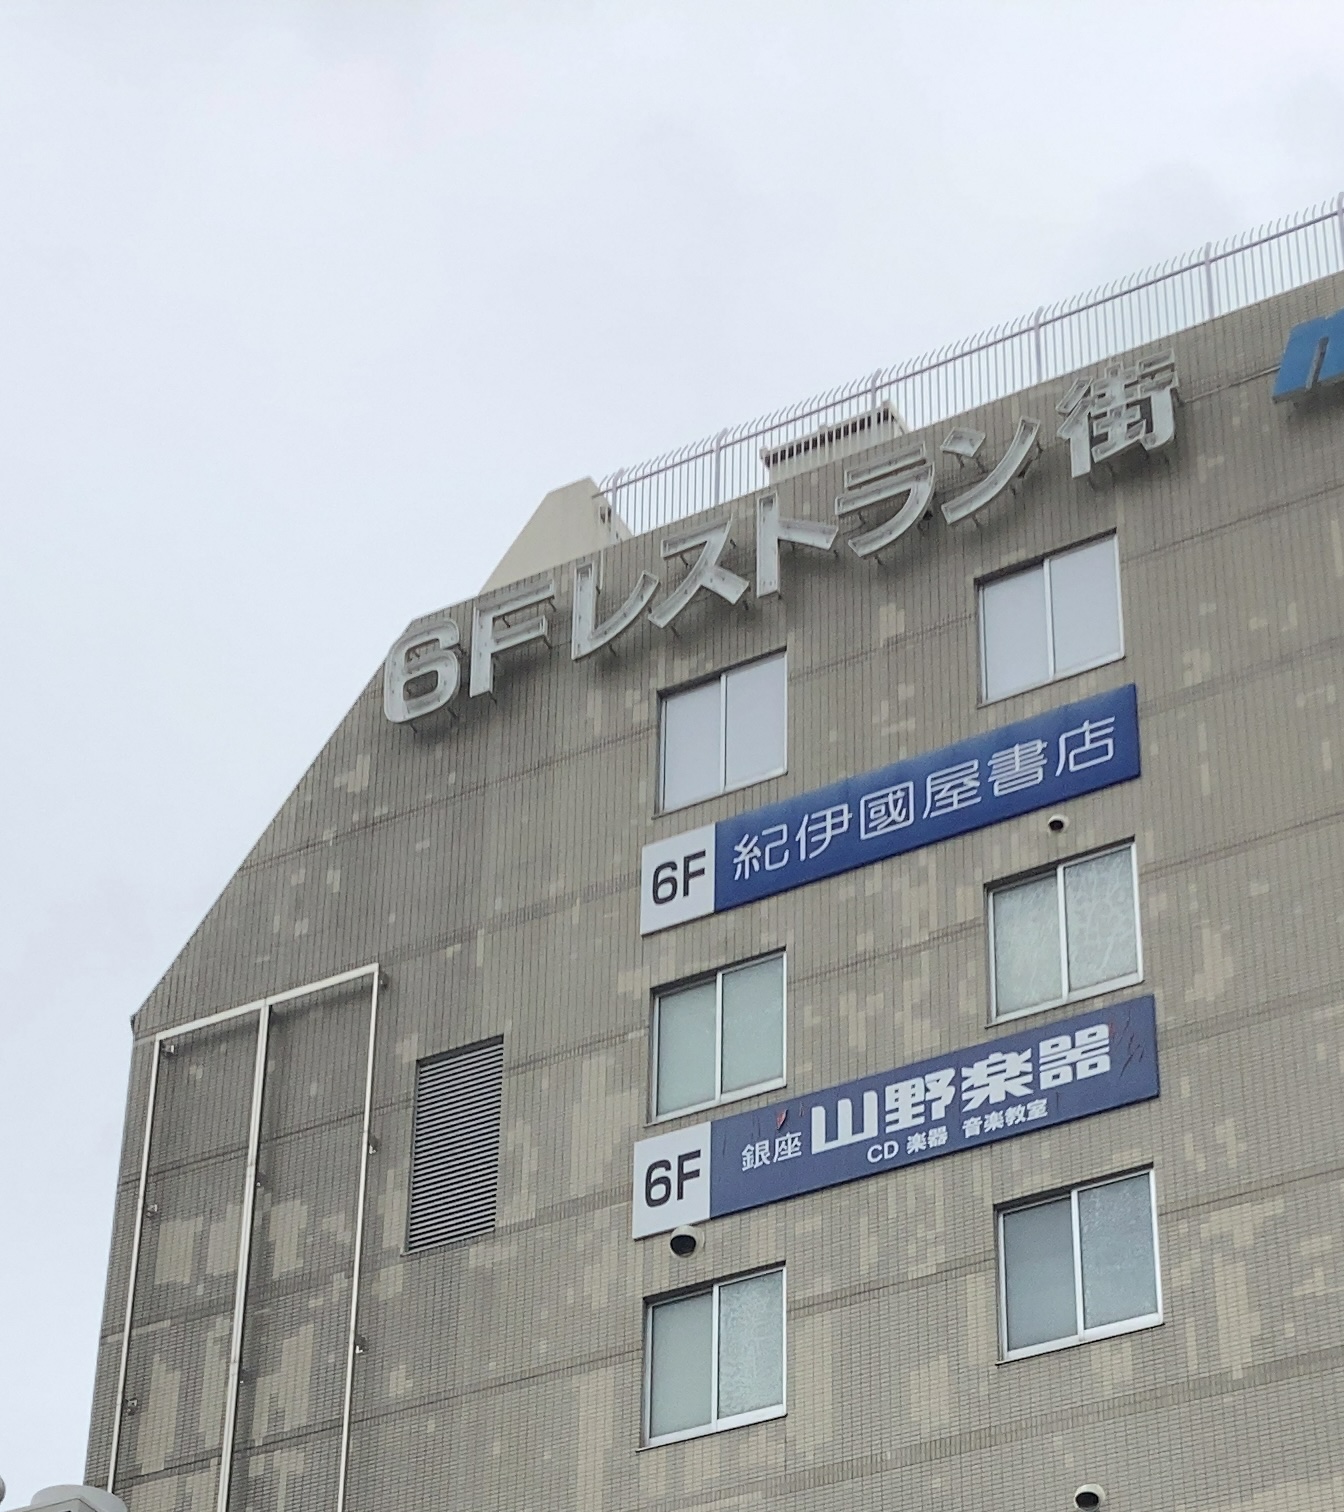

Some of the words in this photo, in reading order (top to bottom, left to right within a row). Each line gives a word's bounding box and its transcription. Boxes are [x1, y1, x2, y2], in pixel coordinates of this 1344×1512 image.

[651, 849, 707, 906] 6F
[732, 715, 1117, 882] 紀伊國屋書店
[644, 1149, 702, 1208] 6F
[741, 1131, 803, 1172] 銀座
[811, 1023, 1112, 1154] 山野楽器
[866, 1140, 899, 1164] CD
[962, 1098, 1049, 1139] 音楽教室
